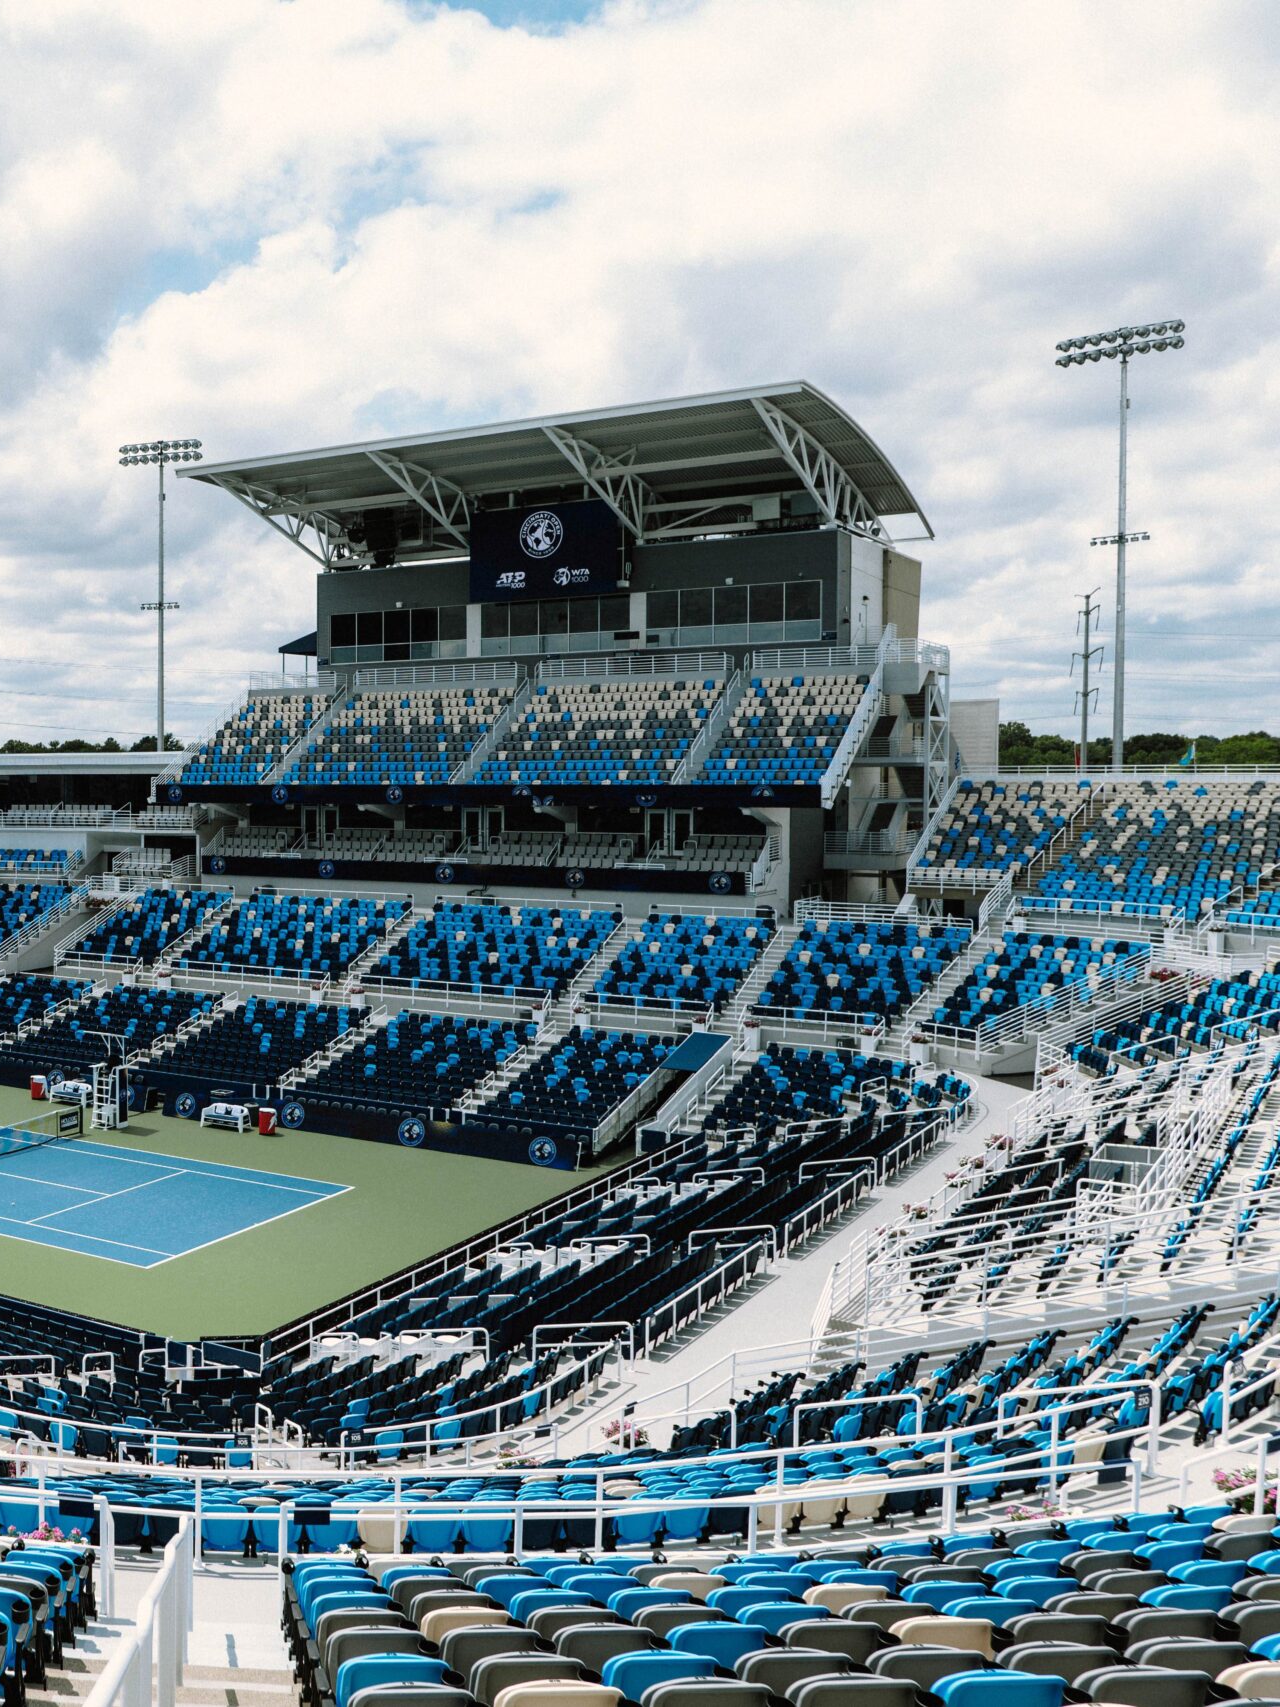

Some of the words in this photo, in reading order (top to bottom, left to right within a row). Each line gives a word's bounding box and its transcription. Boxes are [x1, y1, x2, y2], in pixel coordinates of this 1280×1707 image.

[522, 513, 550, 538] CINCINNATI
[551, 517, 561, 535] OPEN
[571, 568, 590, 576] WTA
[496, 571, 526, 584] ATP
[571, 575, 589, 583] 1000
[1138, 1396, 1150, 1406] 210
